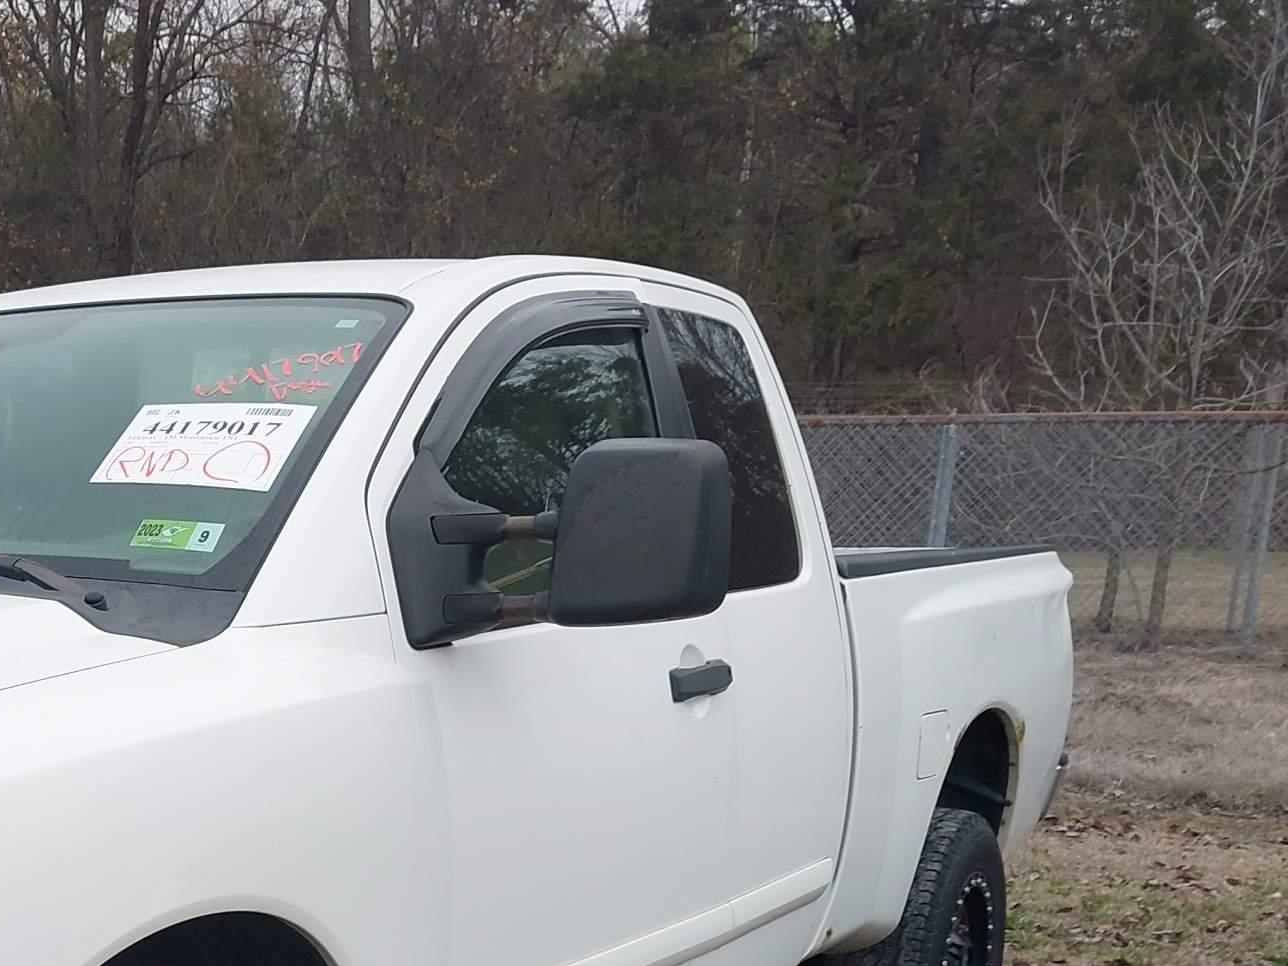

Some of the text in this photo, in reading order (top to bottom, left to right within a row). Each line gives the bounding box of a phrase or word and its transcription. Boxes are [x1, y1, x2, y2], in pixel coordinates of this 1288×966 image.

[143, 420, 283, 437] 44179017
[136, 523, 165, 537] 2023
[197, 529, 210, 543] 9
